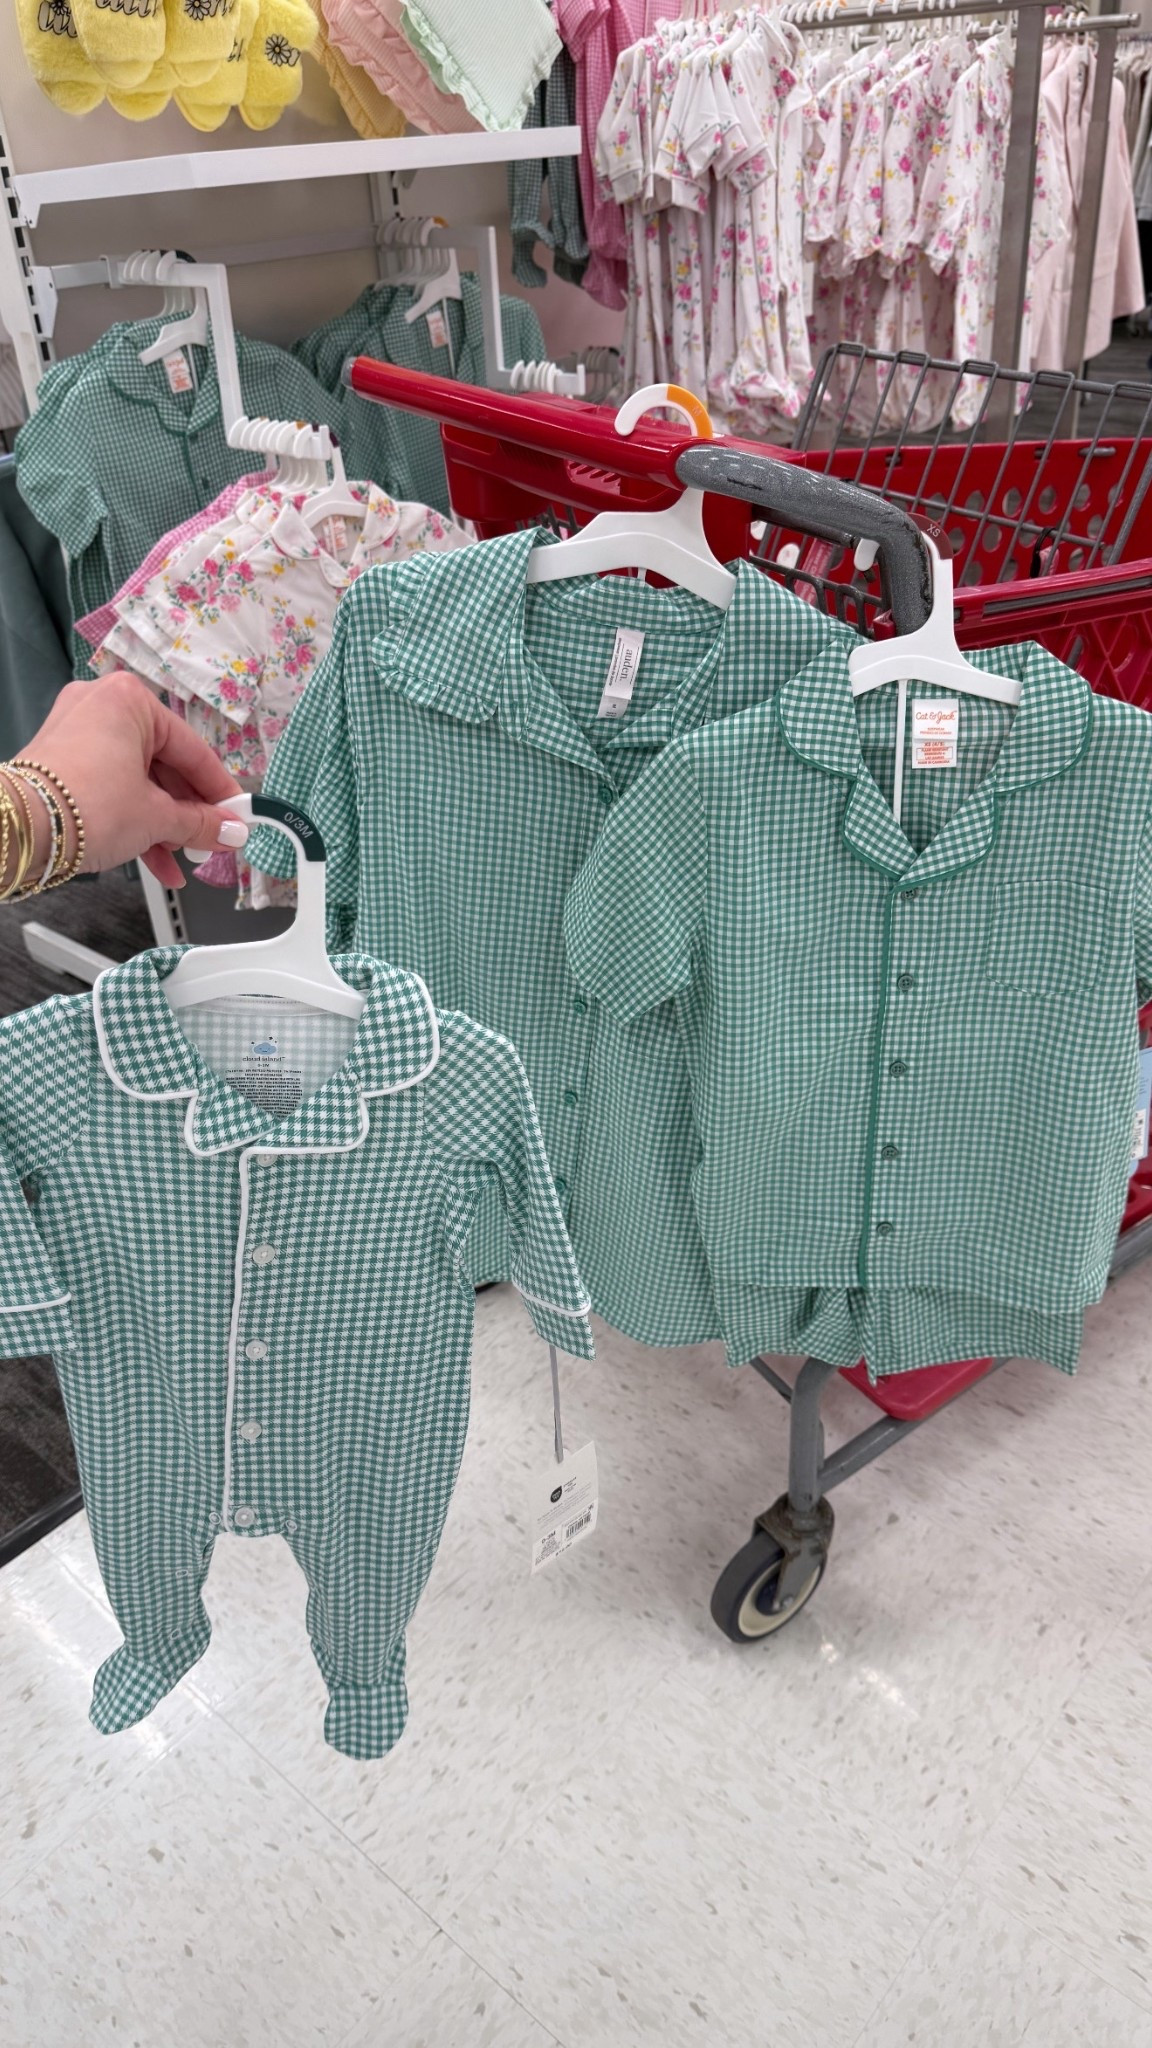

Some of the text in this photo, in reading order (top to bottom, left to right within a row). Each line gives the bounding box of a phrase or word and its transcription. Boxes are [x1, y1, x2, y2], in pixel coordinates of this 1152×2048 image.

[926, 523, 941, 537] XS
[915, 710, 957, 724] Cat & Jack
[284, 812, 314, 838] 0/3M
